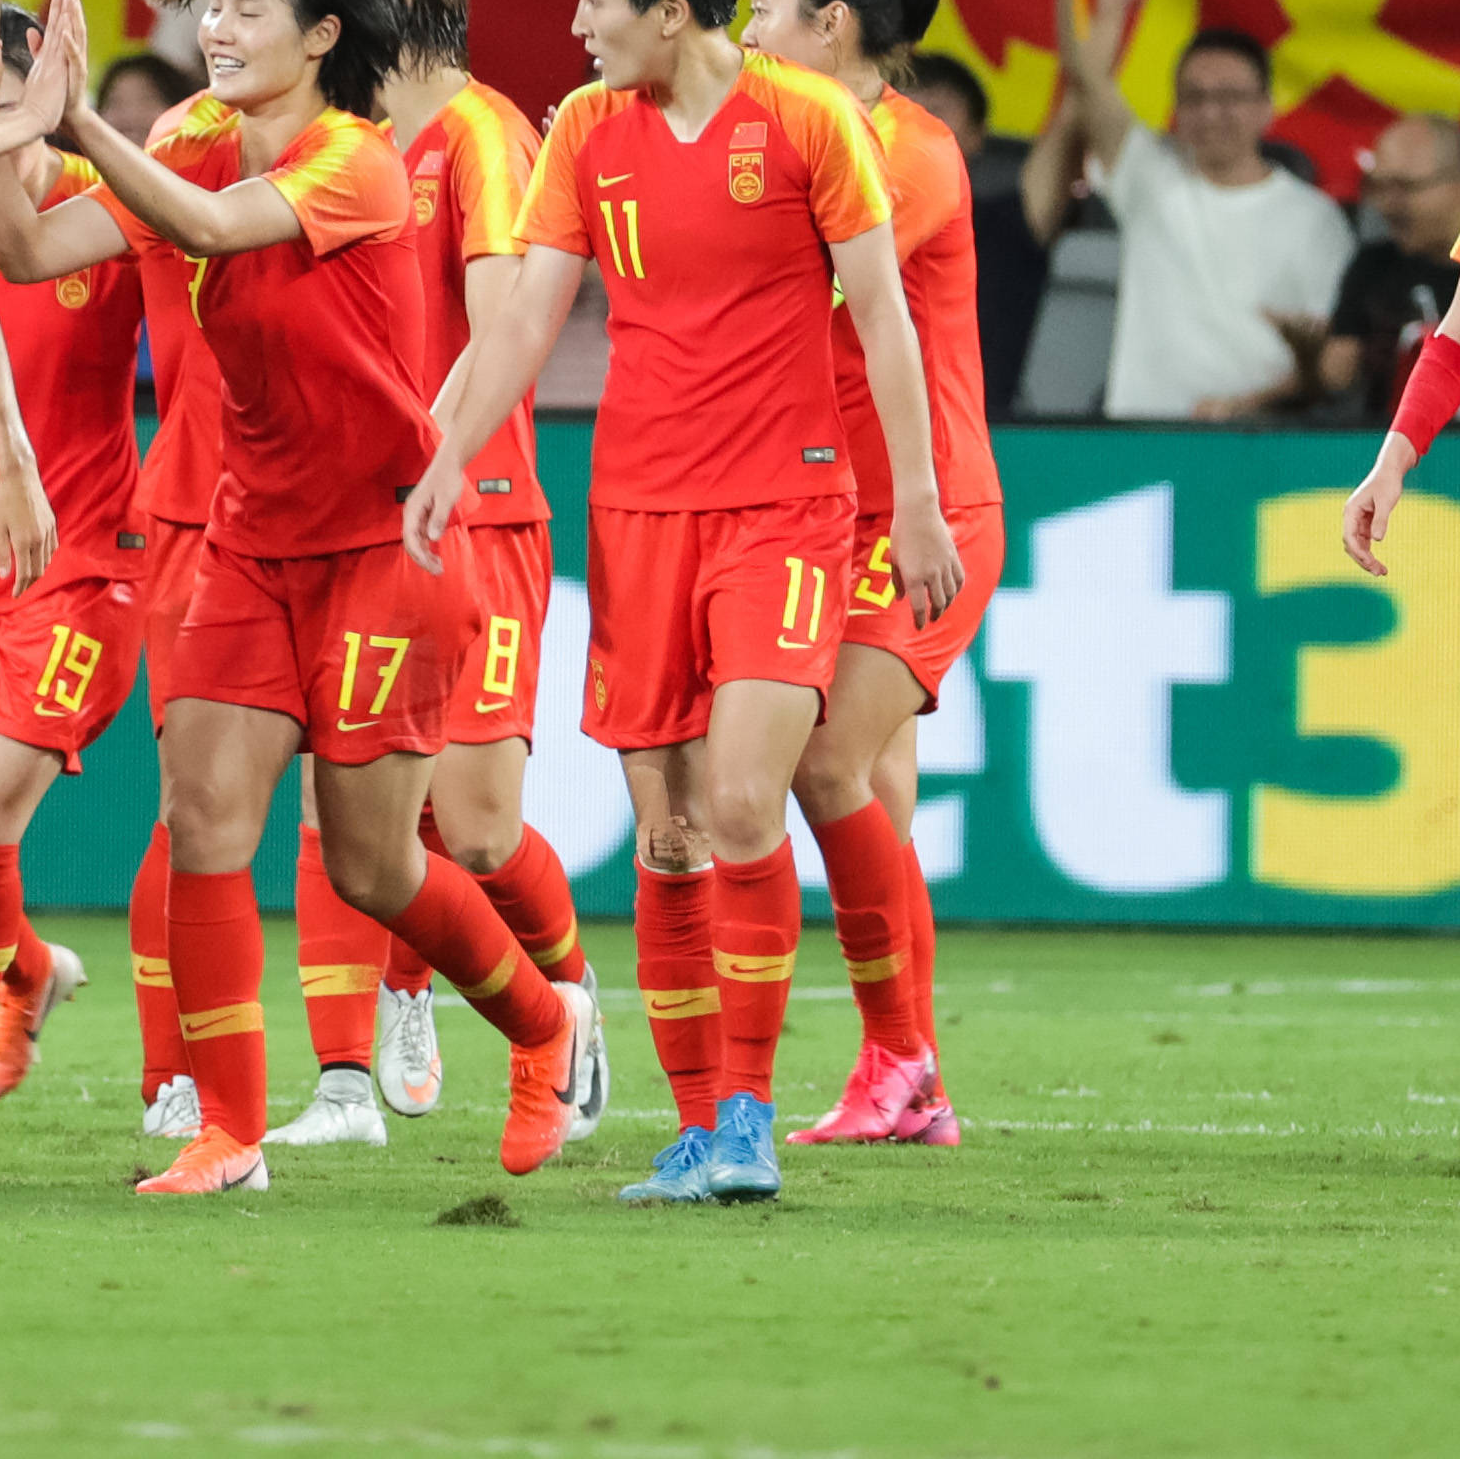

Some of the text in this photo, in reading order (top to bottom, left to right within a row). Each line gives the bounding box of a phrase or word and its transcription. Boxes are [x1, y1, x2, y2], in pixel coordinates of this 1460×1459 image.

[599, 200, 645, 279] 11
[781, 557, 826, 642] 11
[33, 624, 103, 710] 19
[337, 631, 410, 715] 17
[482, 616, 521, 698] 8
